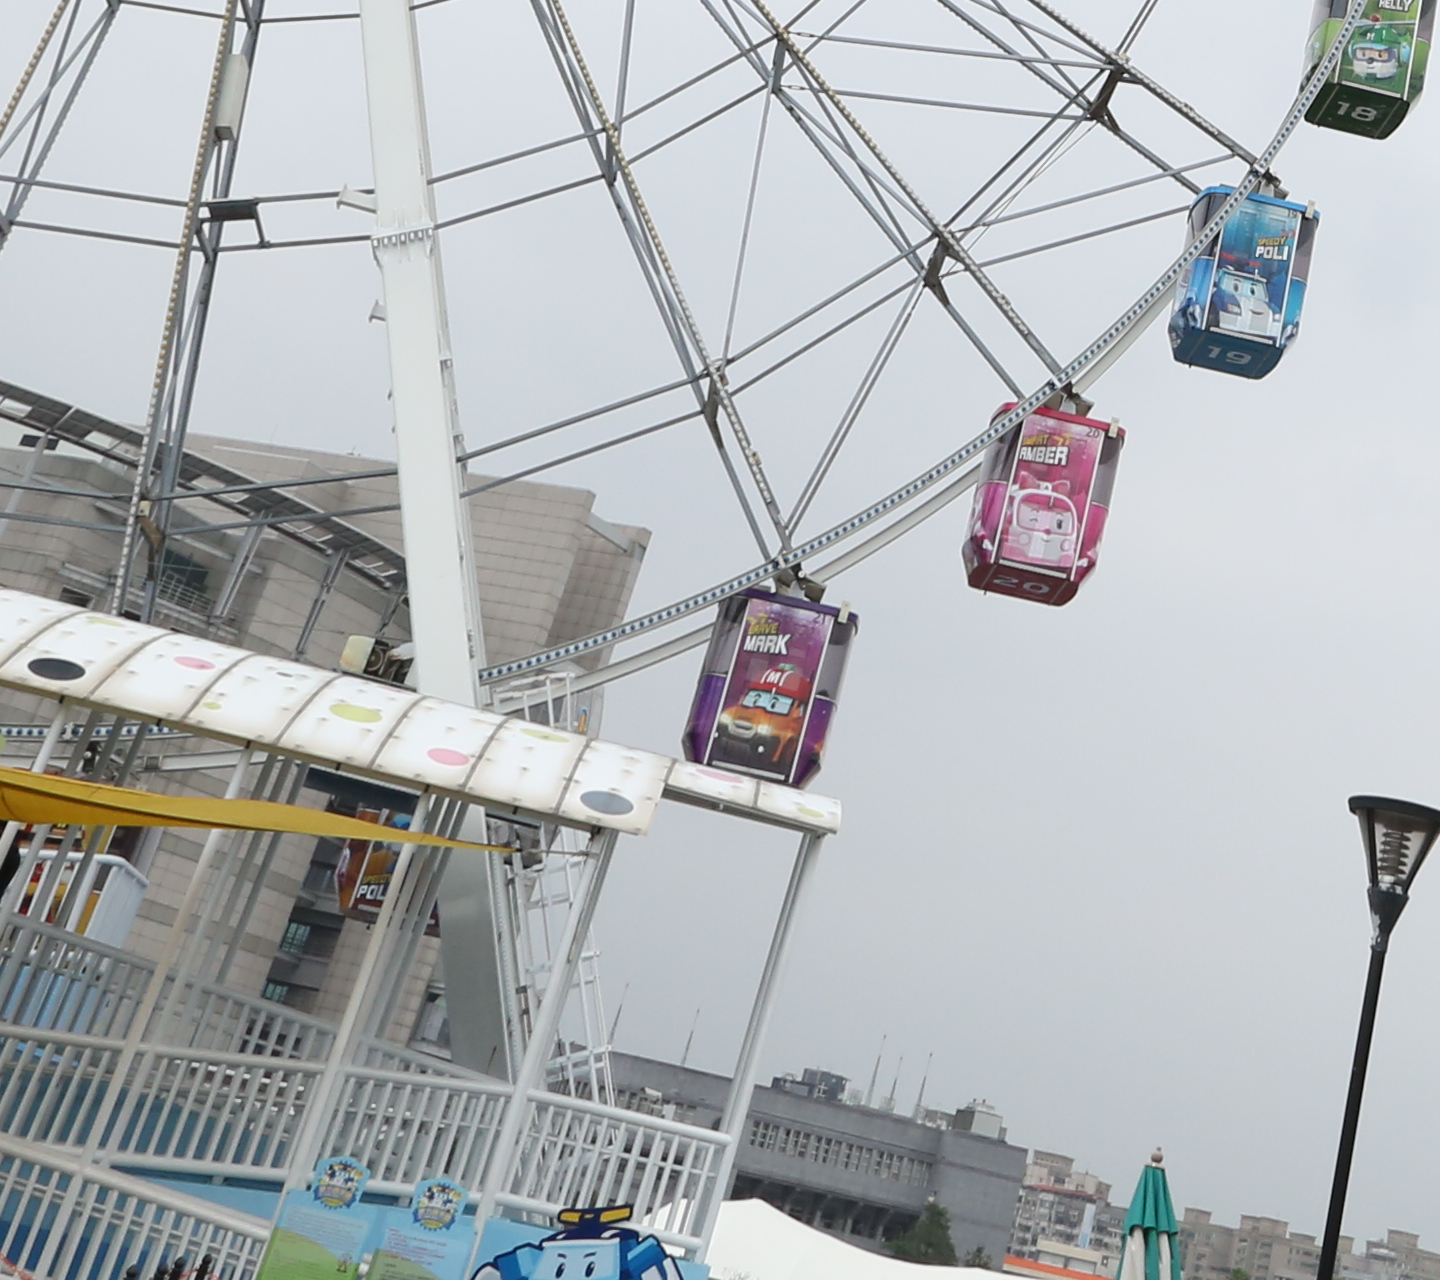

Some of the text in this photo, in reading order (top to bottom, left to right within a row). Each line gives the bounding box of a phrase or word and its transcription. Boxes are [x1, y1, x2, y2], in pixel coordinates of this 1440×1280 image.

[1337, 101, 1377, 122] 18
[1255, 245, 1288, 261] POLI
[1208, 345, 1252, 365] 19
[1086, 428, 1100, 438] 20
[1019, 446, 1070, 466] AMBER
[992, 574, 1050, 595] 20
[743, 633, 791, 655] MARK
[356, 884, 387, 900] POL
